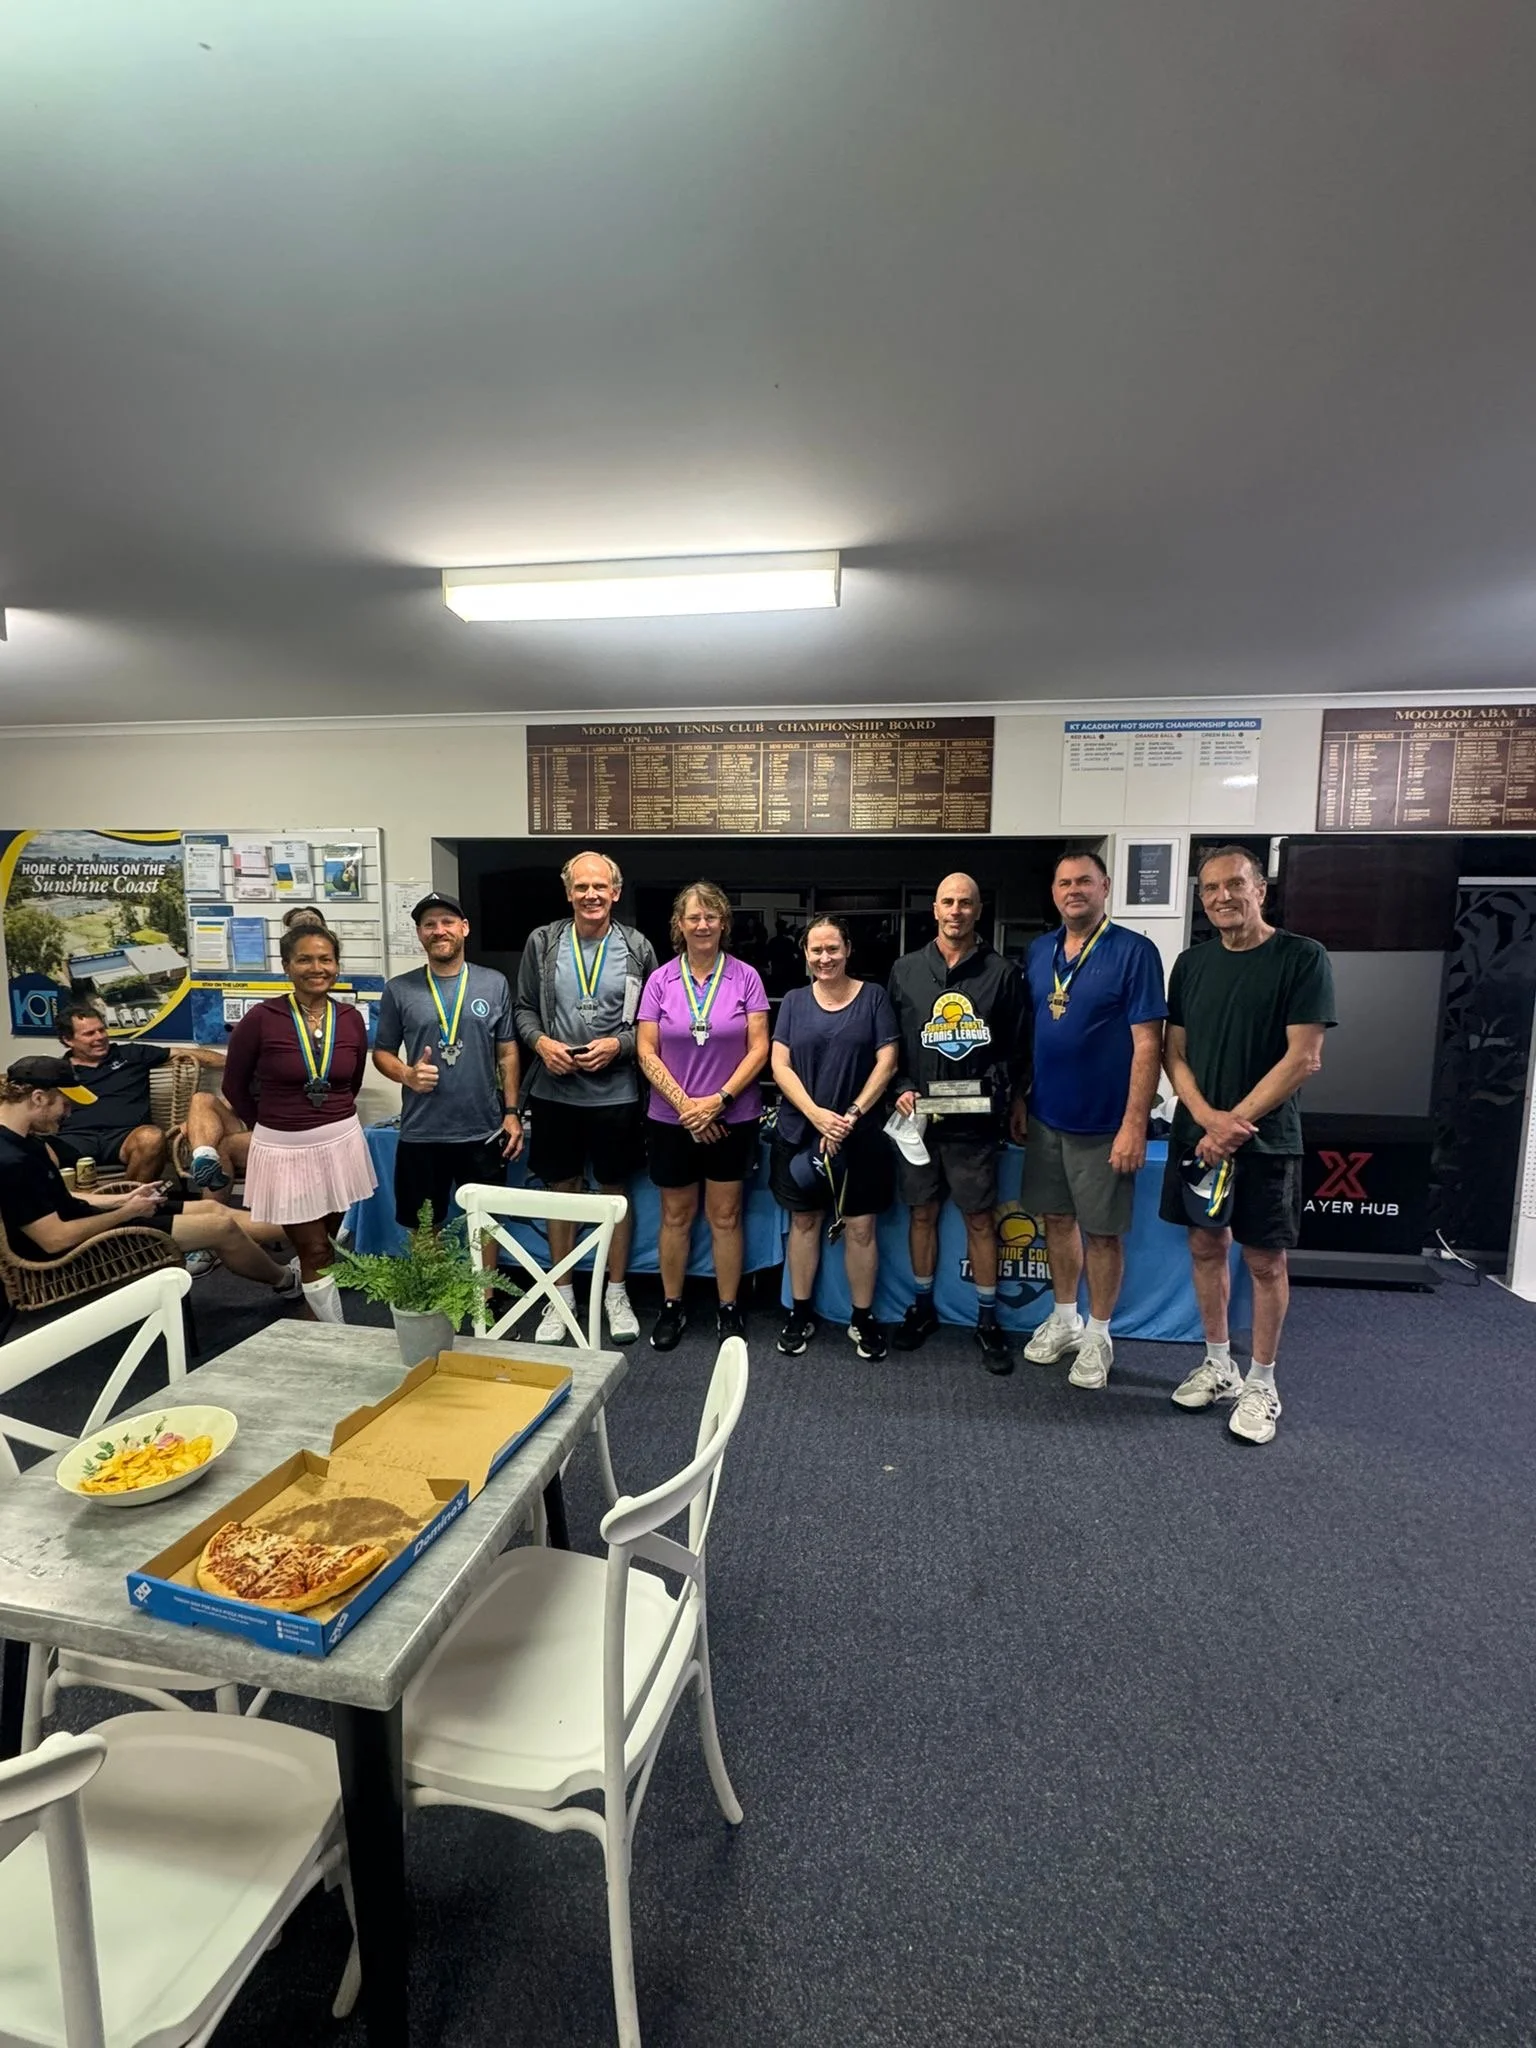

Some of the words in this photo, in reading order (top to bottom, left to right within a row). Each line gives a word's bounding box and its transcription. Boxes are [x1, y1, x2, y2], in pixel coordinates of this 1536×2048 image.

[1395, 709, 1508, 720] MOOLOOLABA
[581, 725, 670, 736] MOOLOOLABA
[677, 724, 724, 734] TENNIS
[729, 723, 764, 733] CLUB
[778, 721, 884, 733] CHAMPIONSHIP
[889, 720, 936, 731] BOARD
[1165, 721, 1226, 729] CHAMPIONSHIP
[1227, 720, 1256, 728] BOARD
[1414, 720, 1469, 729] RESERVE
[1473, 719, 1517, 728] GRADE
[844, 732, 901, 740] VETERANS
[22, 863, 56, 875] HOME
[58, 863, 73, 875] OF
[76, 863, 119, 875] TENNIS
[121, 863, 140, 875] ON
[143, 864, 166, 875] THE
[32, 875, 109, 893] Sunshine
[113, 875, 159, 893] Coast
[960, 1020, 982, 1030] COAST
[924, 1030, 953, 1044] TENNIS
[955, 1029, 988, 1041] LEAGUE
[1360, 1202, 1399, 1216] HUB
[413, 1494, 466, 1557] Domino's
